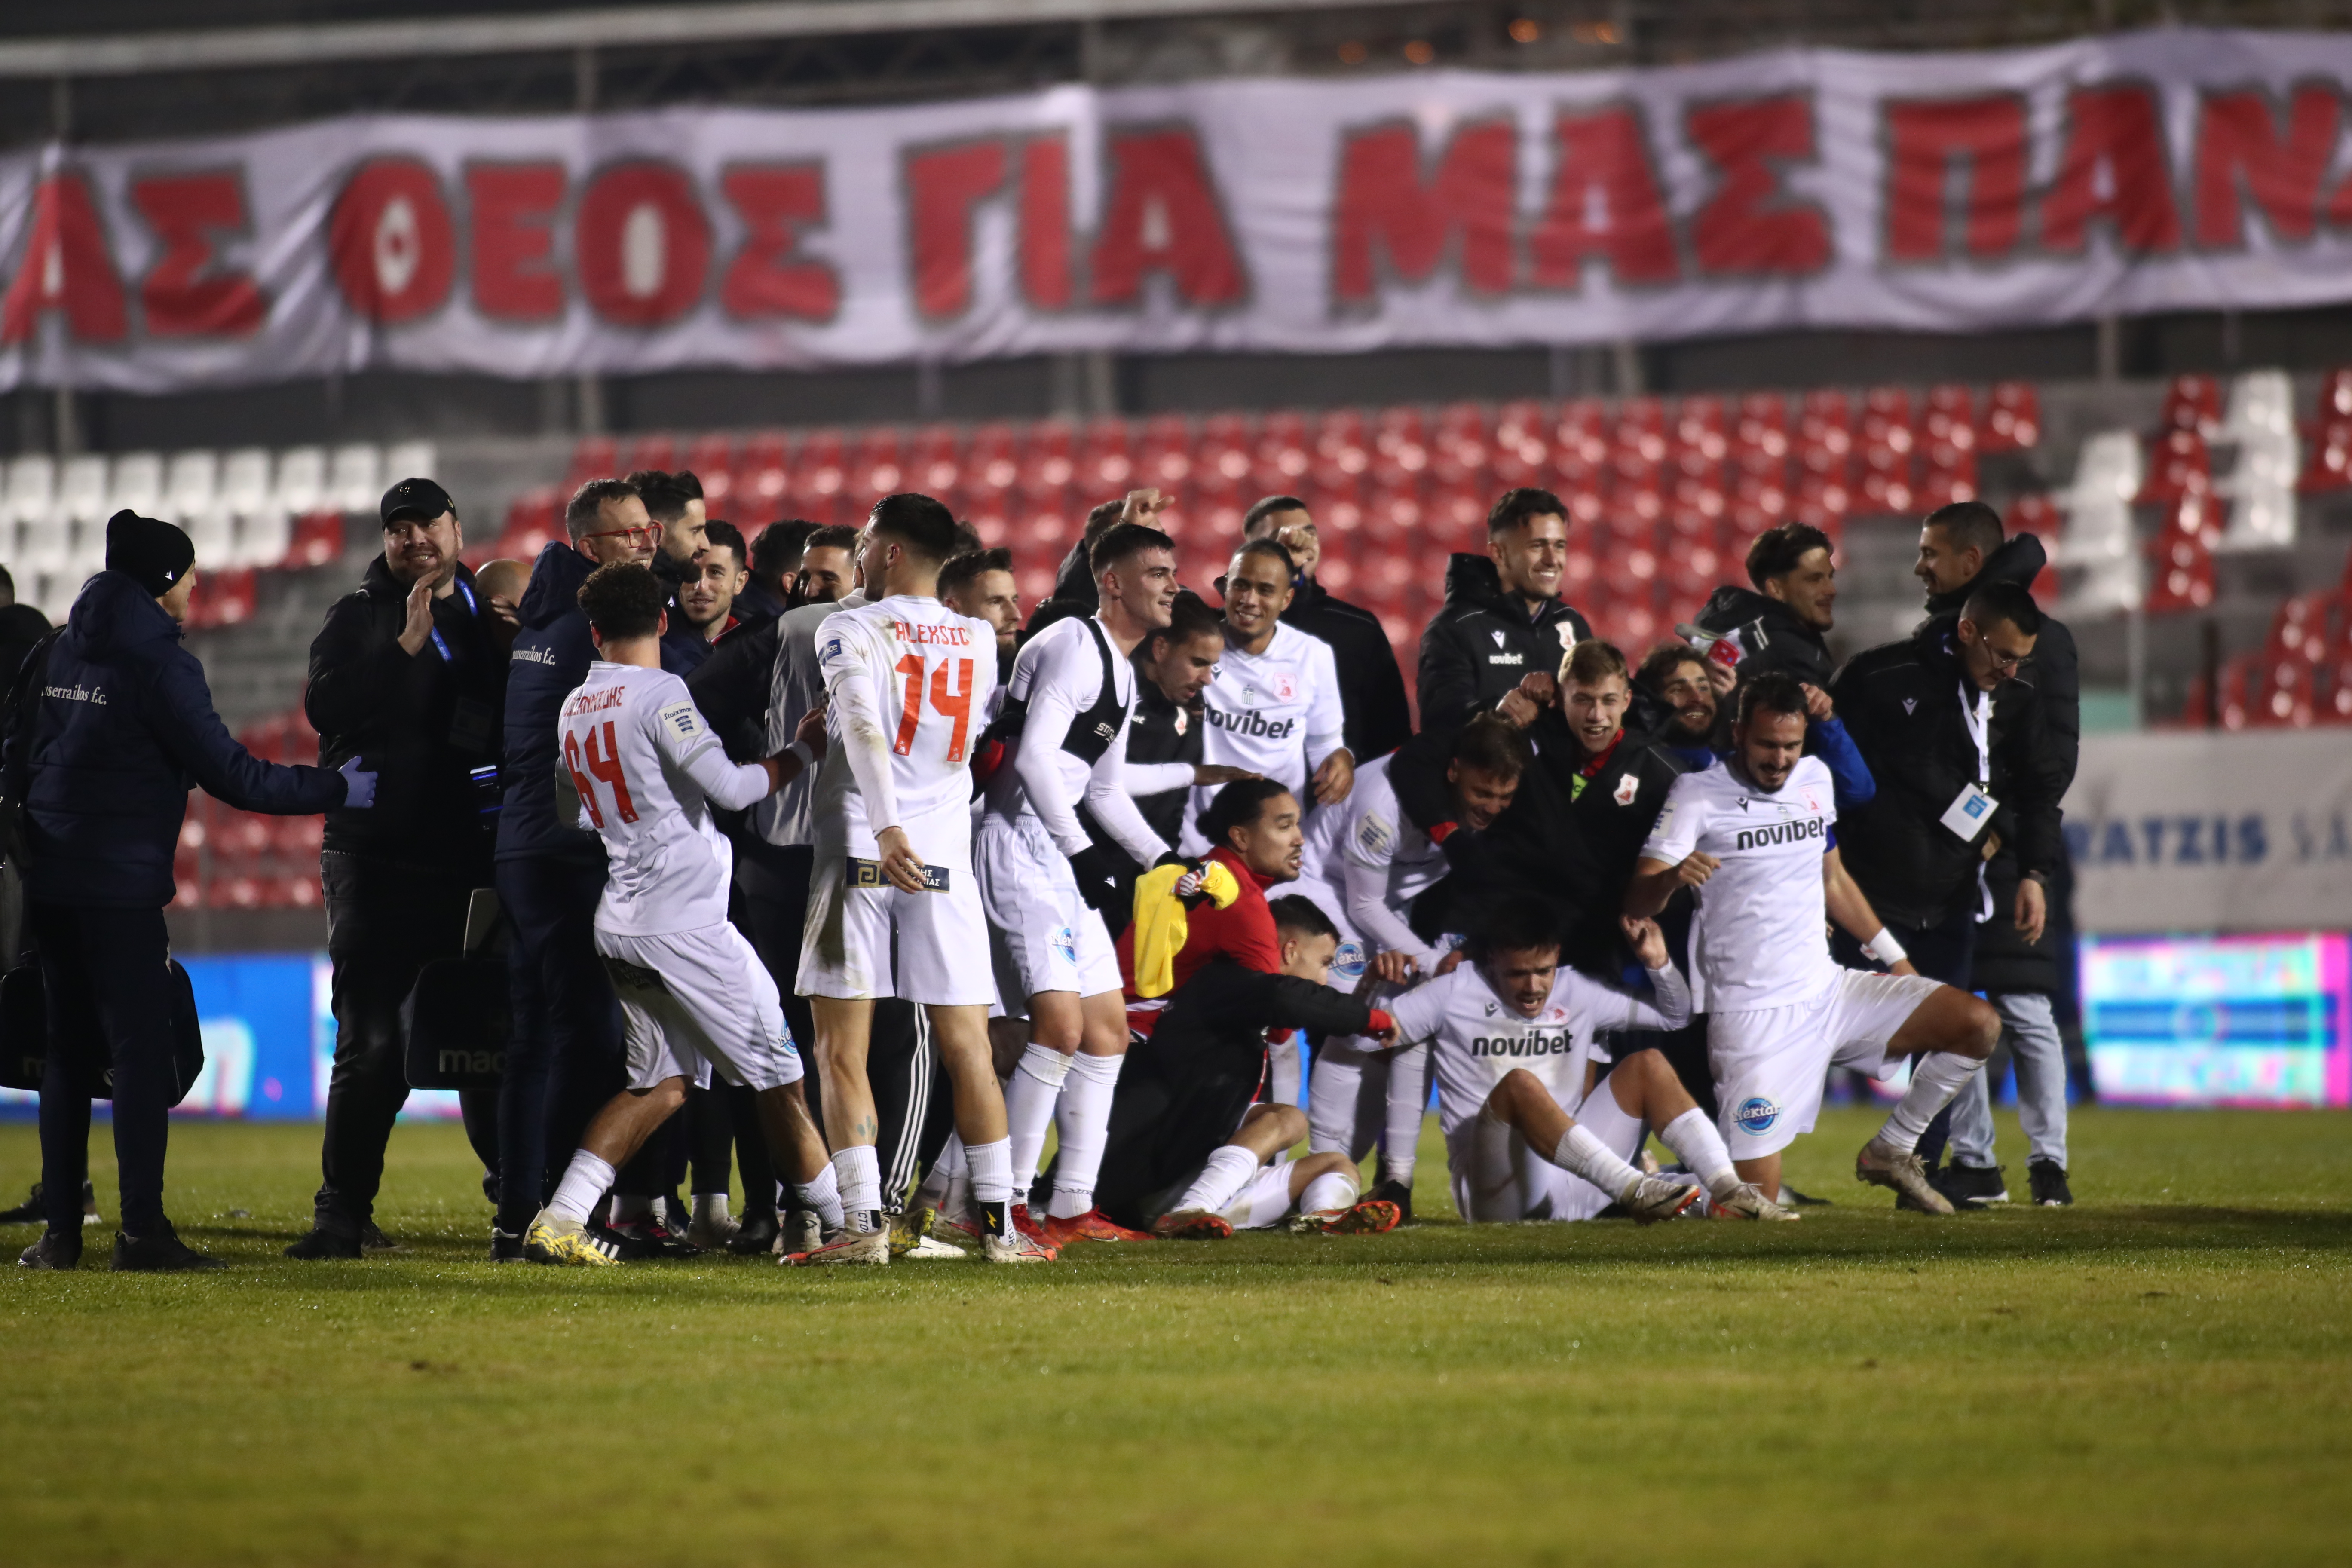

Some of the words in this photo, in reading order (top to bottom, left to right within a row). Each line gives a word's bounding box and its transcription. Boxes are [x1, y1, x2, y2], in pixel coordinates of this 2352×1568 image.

[328, 155, 839, 330] ΘΕΟΣ
[900, 121, 1252, 322] ΓΙΑ
[1330, 95, 1832, 313] ΜΑΣ
[1883, 80, 2352, 265] ΠΑΝ
[895, 622, 970, 646] ALEKSIC
[542, 647, 555, 666] f.c.
[1489, 653, 1522, 664] novibet
[90, 686, 107, 705] f.c.
[893, 654, 974, 762] 14
[664, 708, 692, 720] Stoiximan
[564, 721, 640, 828] 64
[1737, 816, 1824, 851] novibet
[1472, 1029, 1573, 1056] novibet
